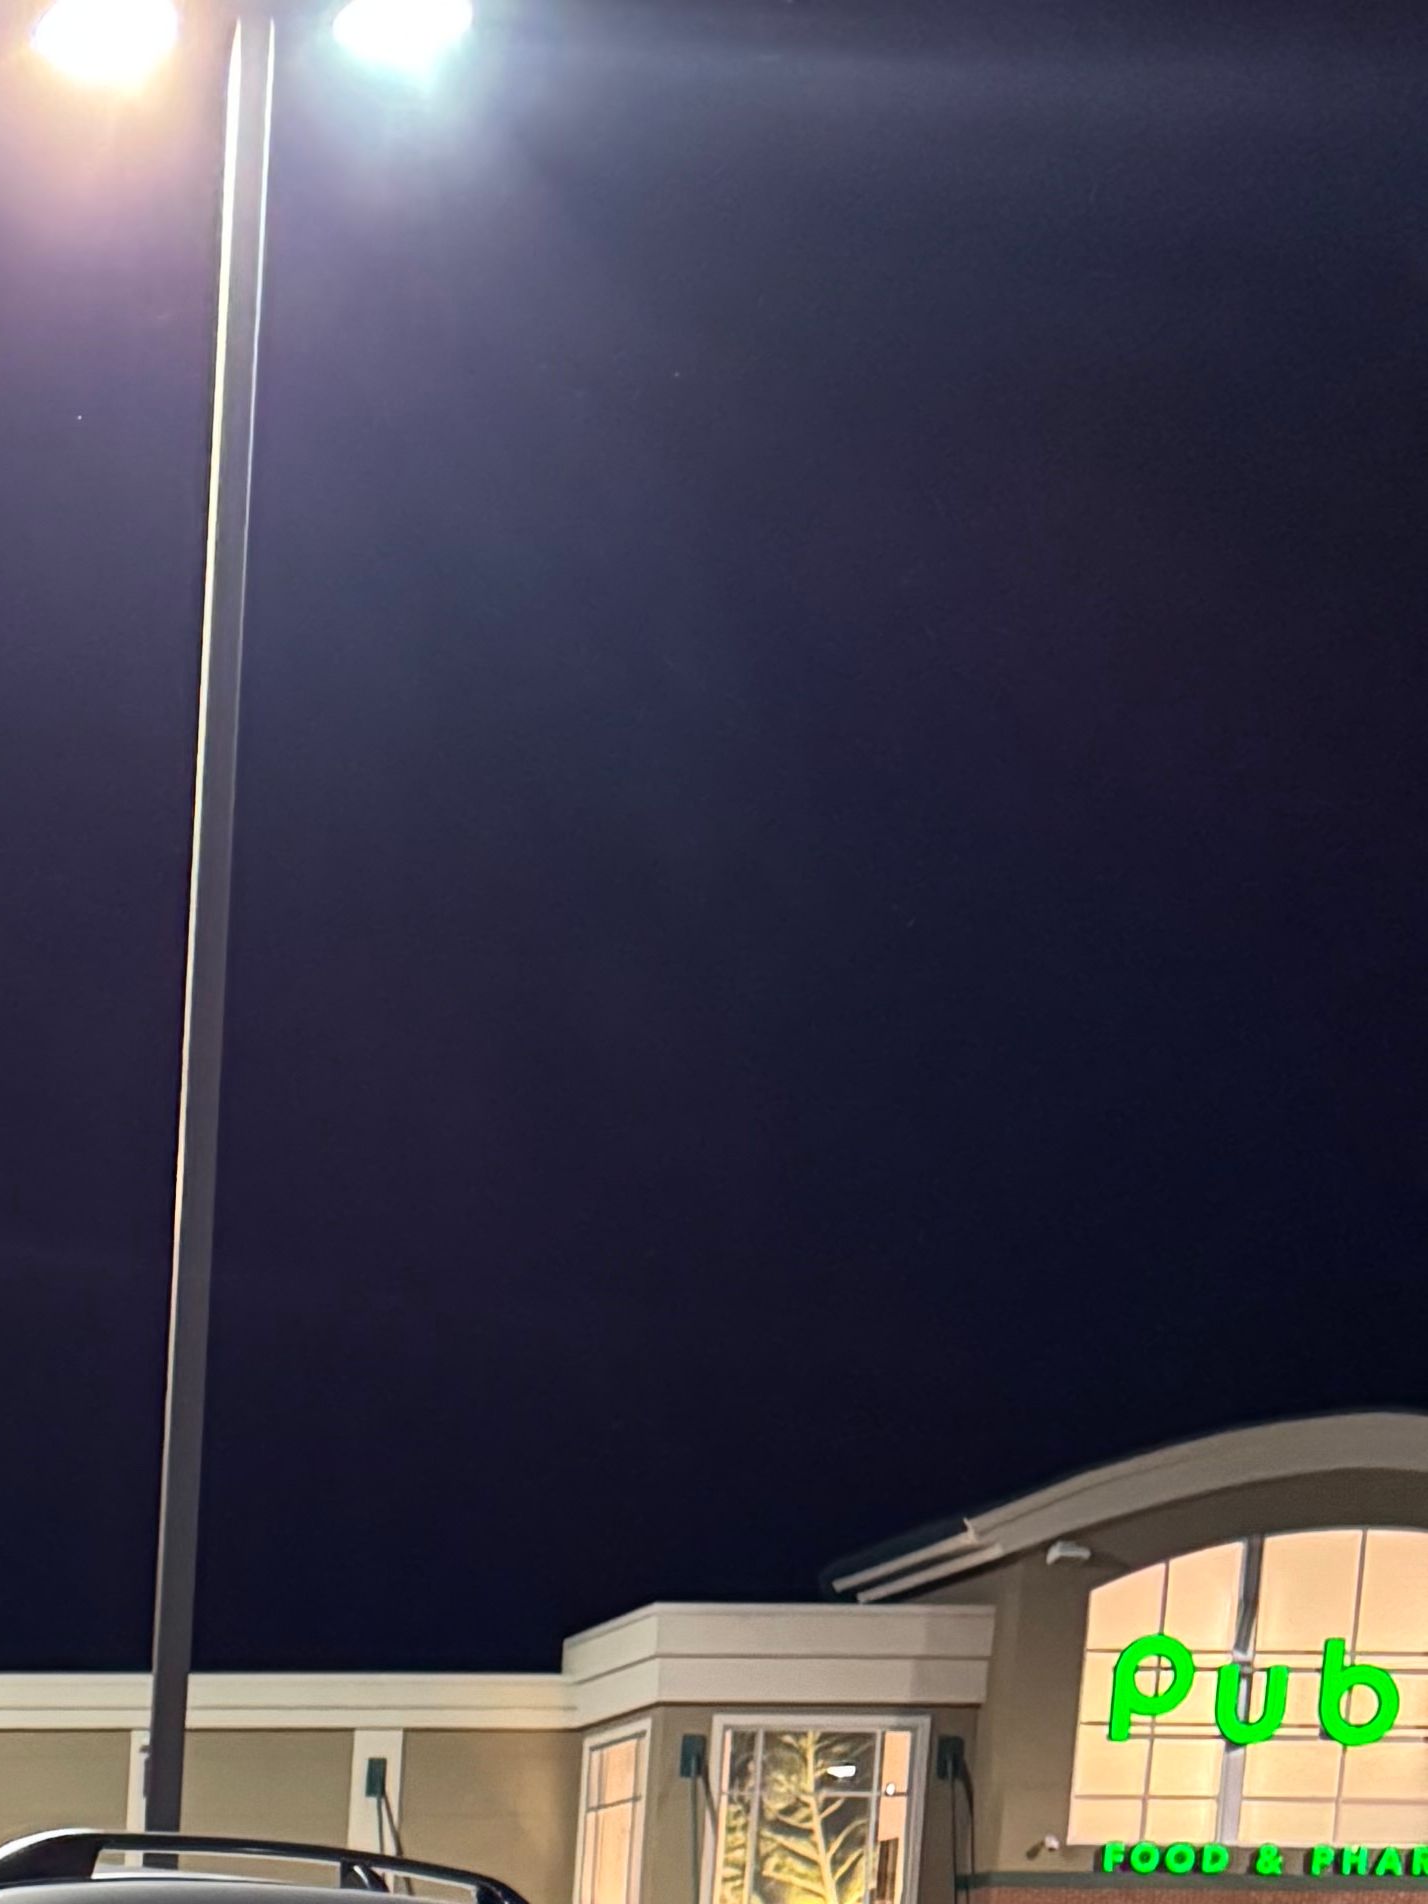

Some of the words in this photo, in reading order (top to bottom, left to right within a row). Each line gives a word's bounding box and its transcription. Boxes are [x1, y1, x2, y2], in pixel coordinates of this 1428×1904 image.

[1108, 1634, 1399, 1746] Pub
[1102, 1842, 1230, 1875] FOOD
[1255, 1842, 1283, 1876] &
